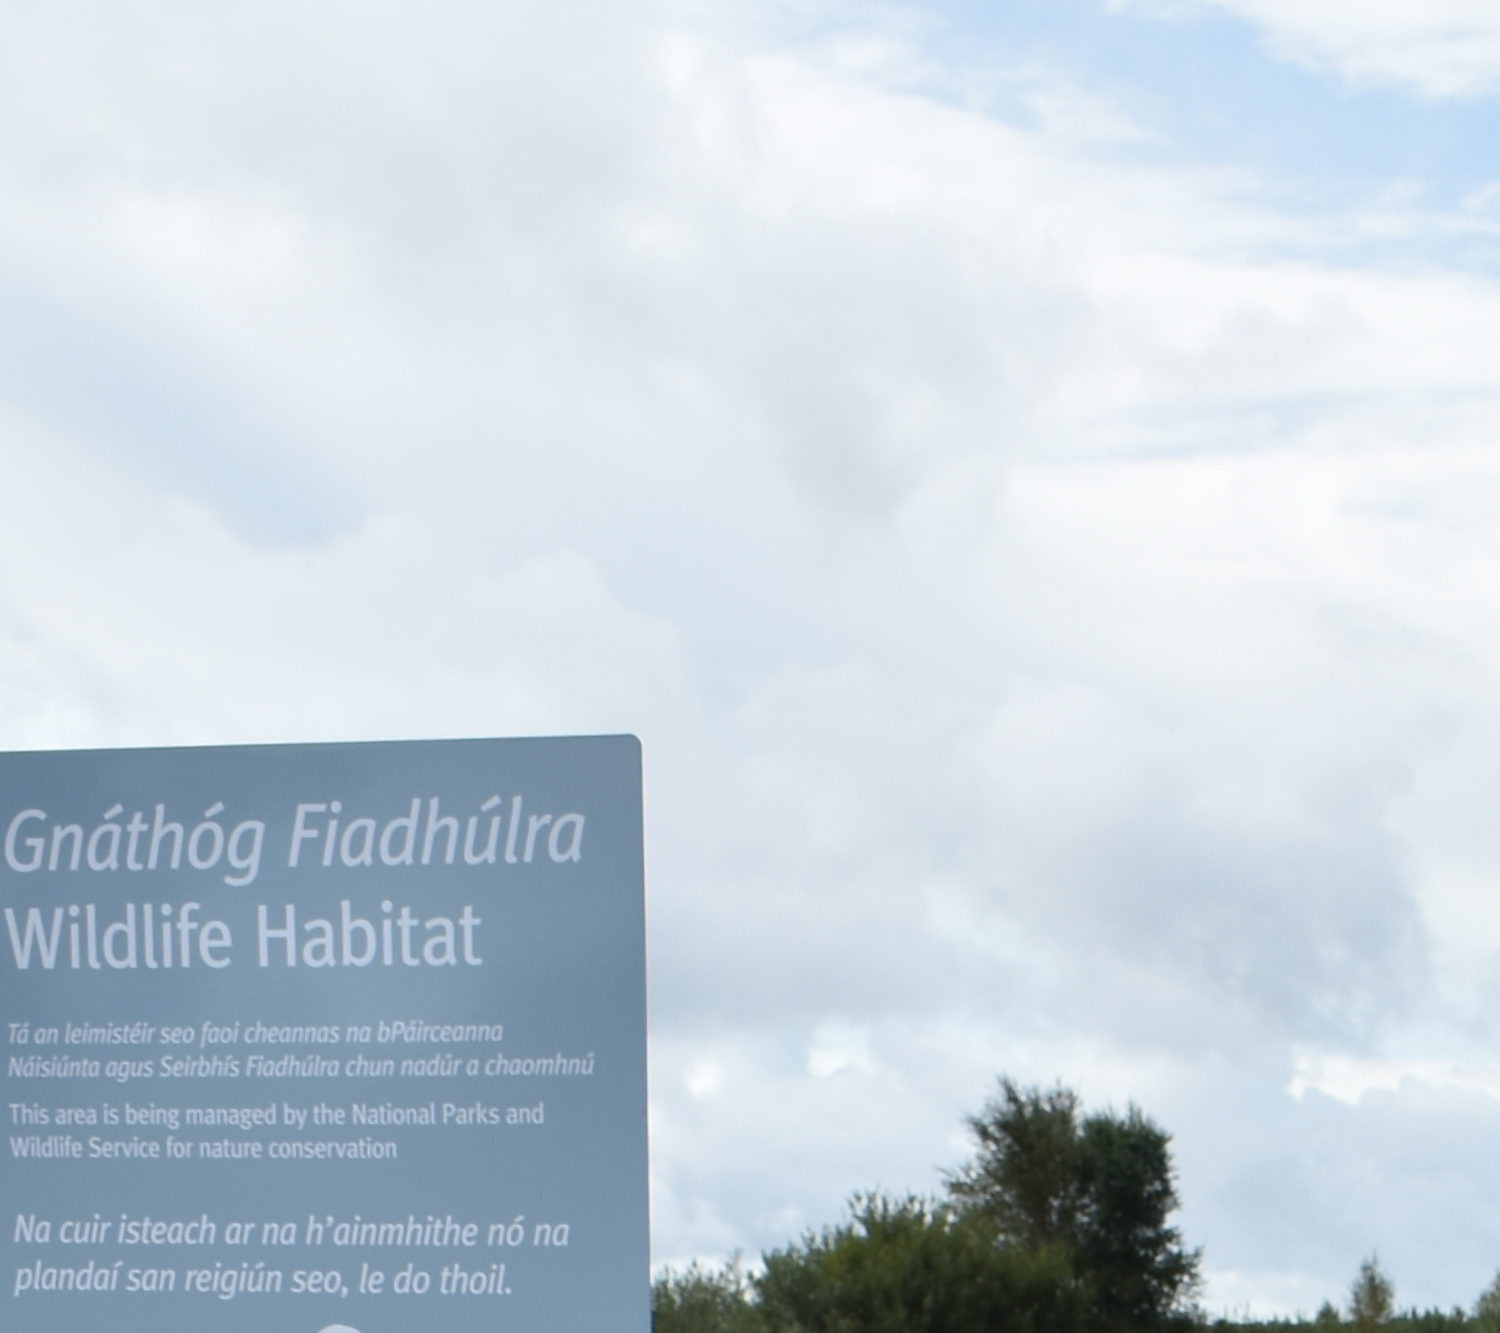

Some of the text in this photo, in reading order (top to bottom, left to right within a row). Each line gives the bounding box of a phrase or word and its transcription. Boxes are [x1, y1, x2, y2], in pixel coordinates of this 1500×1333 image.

[5, 795, 584, 885] Gnáthóg Fiadhúlra
[5, 900, 482, 968] Wildlife Habitat
[9, 1019, 503, 1048] Tá an leimistéir seo faoi cheannas na bPáirceanna
[8, 1052, 594, 1083] Náisiúnta agus Seirbhís Fiadhúlra chun nadúr a chaomhnú
[9, 1101, 544, 1131] This area is being managed by the National Parks and
[10, 1135, 397, 1159] Wildlife Service for nature conservation
[14, 1214, 51, 1243] Na
[59, 1213, 112, 1244] cuir
[117, 1213, 217, 1245] isteach
[224, 1222, 256, 1245] ar
[261, 1222, 297, 1246] na
[487, 1214, 525, 1247] nó
[533, 1223, 570, 1247] na
[14, 1259, 512, 1300] plandaí san reigiún seo, le do thoil.
